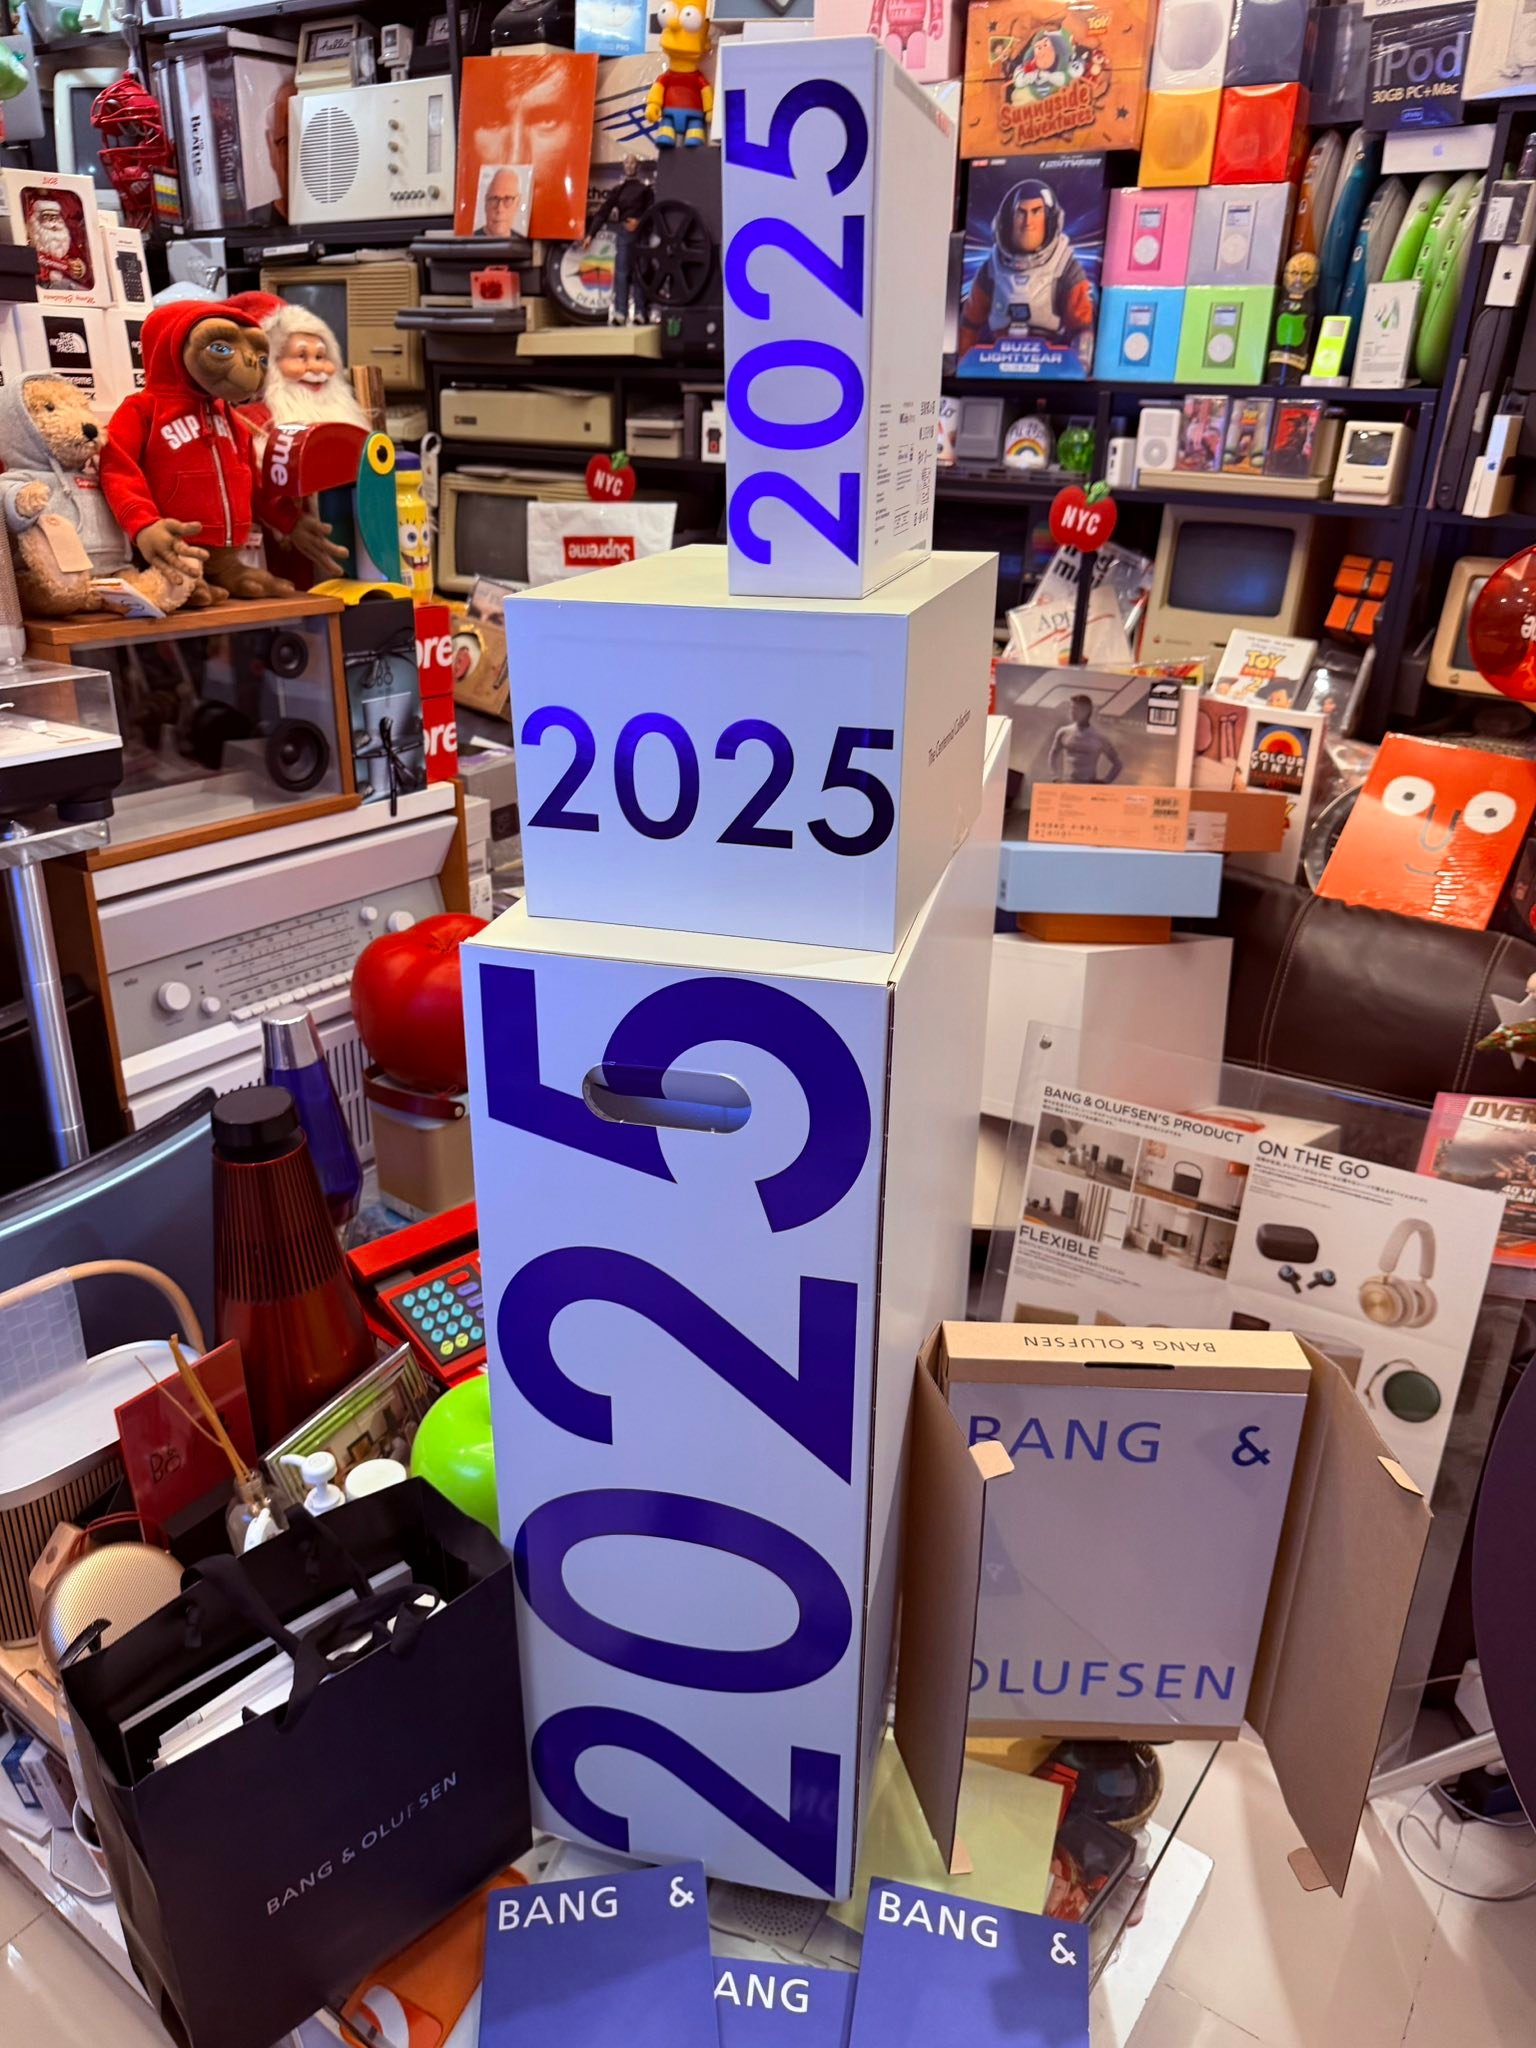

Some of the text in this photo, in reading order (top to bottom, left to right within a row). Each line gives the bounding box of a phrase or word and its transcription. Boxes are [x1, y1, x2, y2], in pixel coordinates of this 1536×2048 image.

[1373, 31, 1465, 87] iPod
[1001, 83, 1089, 127] Sunnyside
[1371, 87, 1405, 104] 30GB
[1015, 108, 1092, 141] Adventures
[724, 78, 868, 566] 2025
[978, 352, 1063, 364] LIGHTYEAR
[1000, 343, 1041, 353] BUZZ
[593, 469, 624, 496] NYC
[1061, 504, 1102, 536] NYC
[567, 537, 631, 563] Supreme
[1245, 649, 1286, 669] TOY
[1250, 760, 1304, 777] VINYL
[1251, 750, 1305, 766] COLOUR
[521, 704, 895, 857] 2025
[1043, 1085, 1083, 1106] BANG
[1083, 1096, 1092, 1106] &
[1094, 1098, 1170, 1126] OLUFSEN'S
[1173, 1118, 1245, 1145] PRODUCT
[1258, 1140, 1370, 1179] ON THE GO
[1019, 1224, 1100, 1260] FLEXIBLE
[1023, 1335, 1217, 1353] BANG & OLUFSEN
[478, 962, 872, 1900] 2025
[968, 1415, 1271, 1467] BANG &
[969, 1658, 1236, 1701] OLUFSEN
[266, 1865, 334, 1916] BANG
[341, 1846, 356, 1864] &
[498, 1875, 696, 1931] BANG &
[878, 1890, 1077, 1967] BANG &
